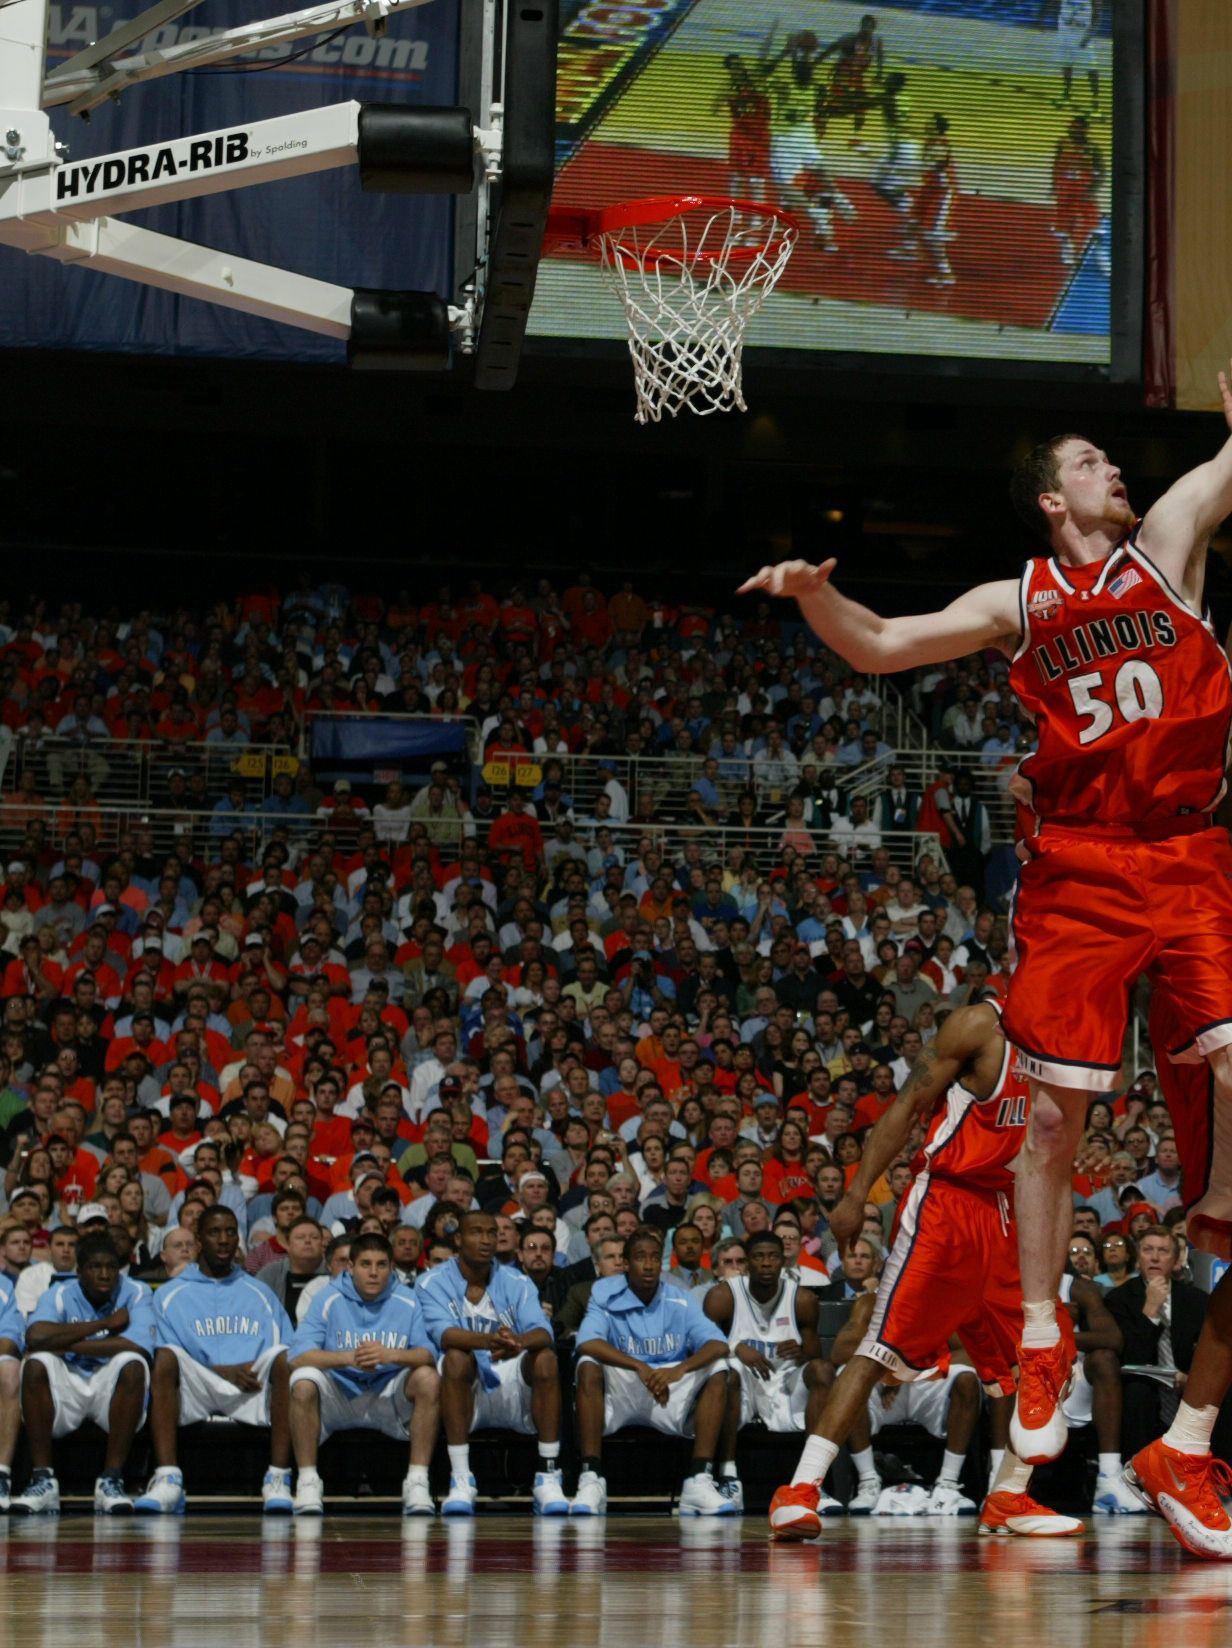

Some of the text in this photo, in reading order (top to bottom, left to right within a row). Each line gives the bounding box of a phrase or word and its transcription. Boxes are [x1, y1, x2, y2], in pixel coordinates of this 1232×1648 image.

[57, 132, 308, 199] HYDRA-RIB by Spalding
[1032, 611, 1176, 687] LLINOIS
[1067, 659, 1164, 745] 50
